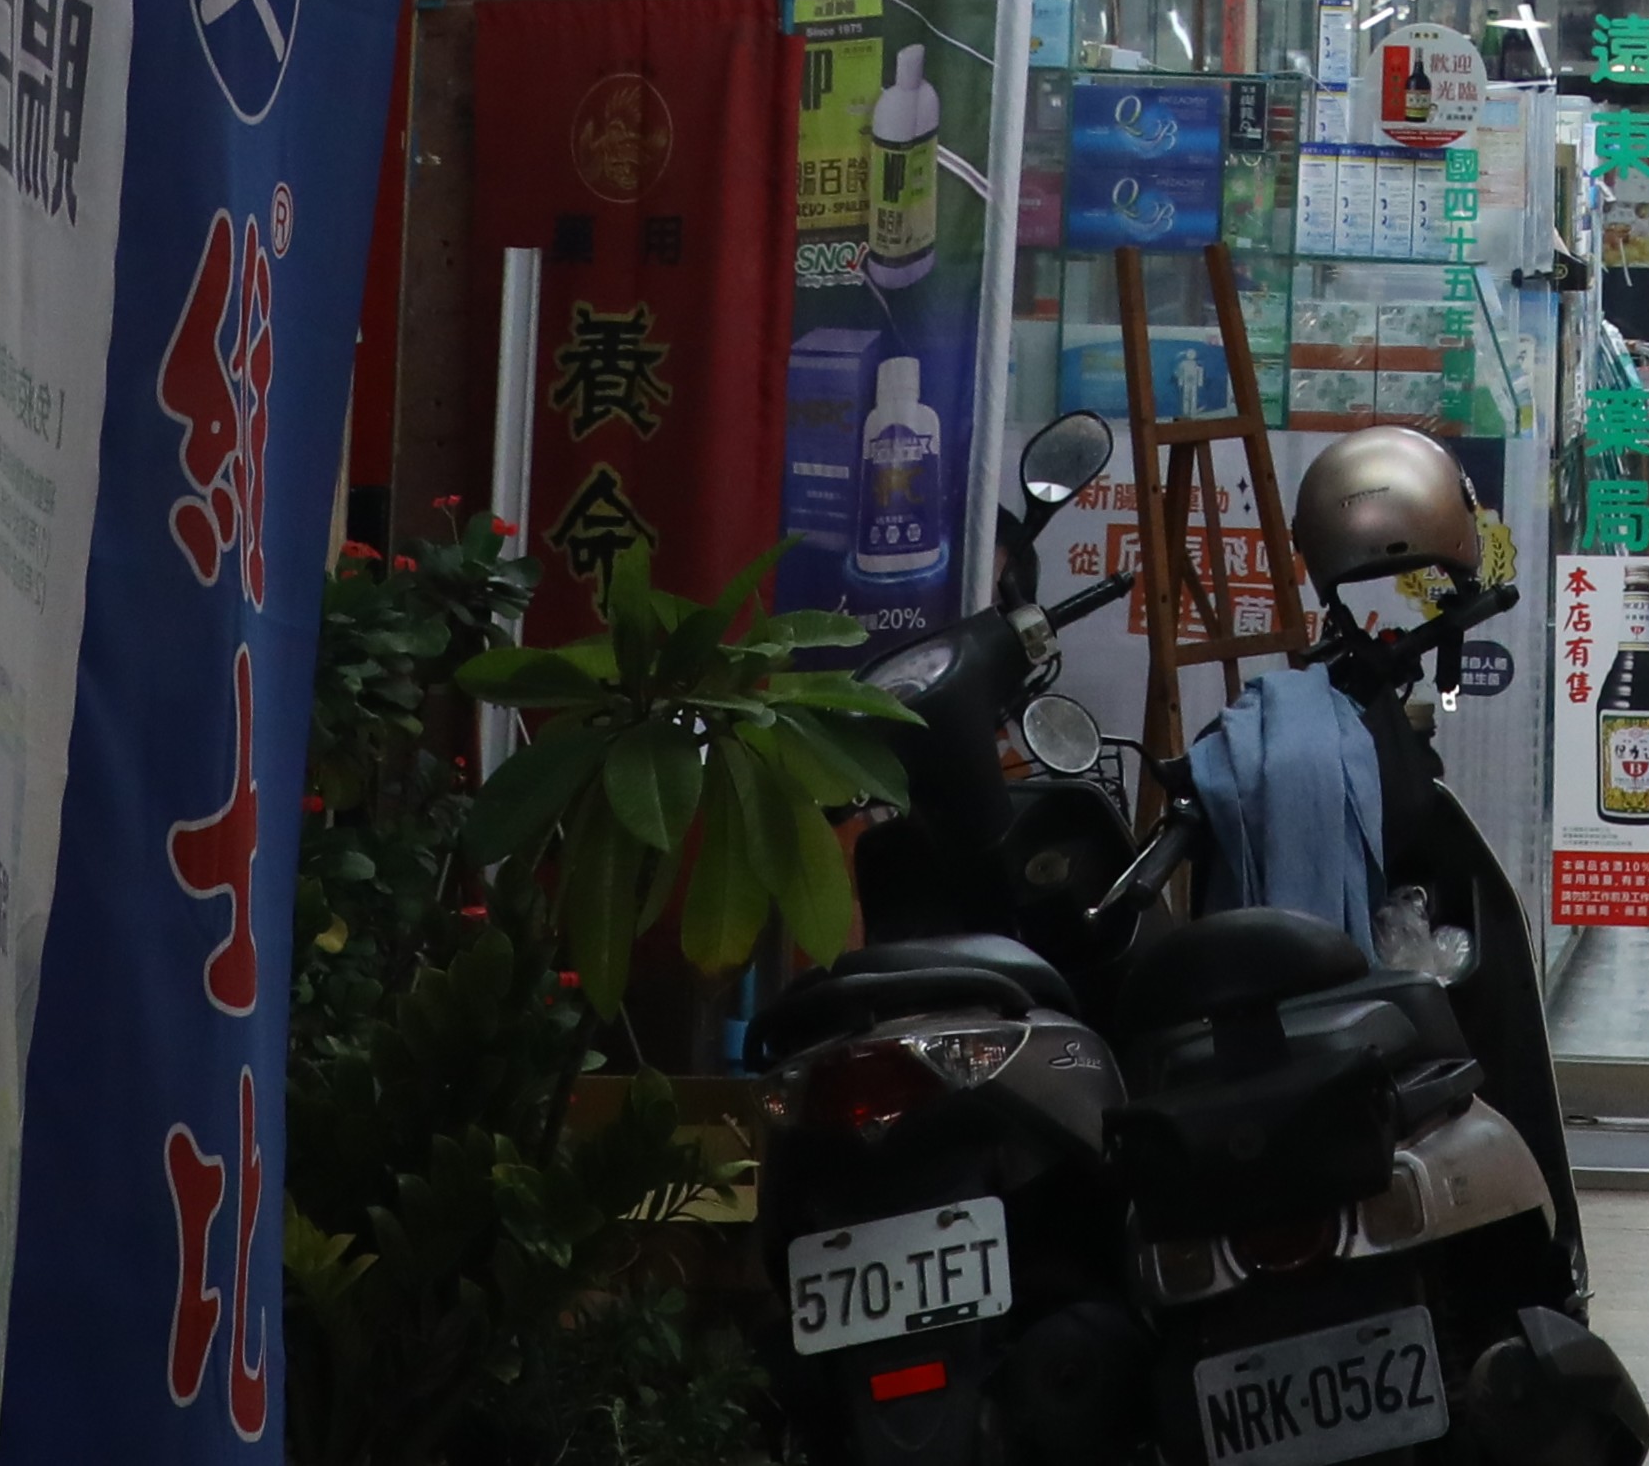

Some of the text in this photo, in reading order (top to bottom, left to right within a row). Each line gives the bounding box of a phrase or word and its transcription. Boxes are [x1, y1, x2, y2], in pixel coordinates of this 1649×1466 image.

[1430, 53, 1472, 74] 歡迎
[1438, 80, 1478, 102] 光臨
[1563, 567, 1598, 705] 本店有售
